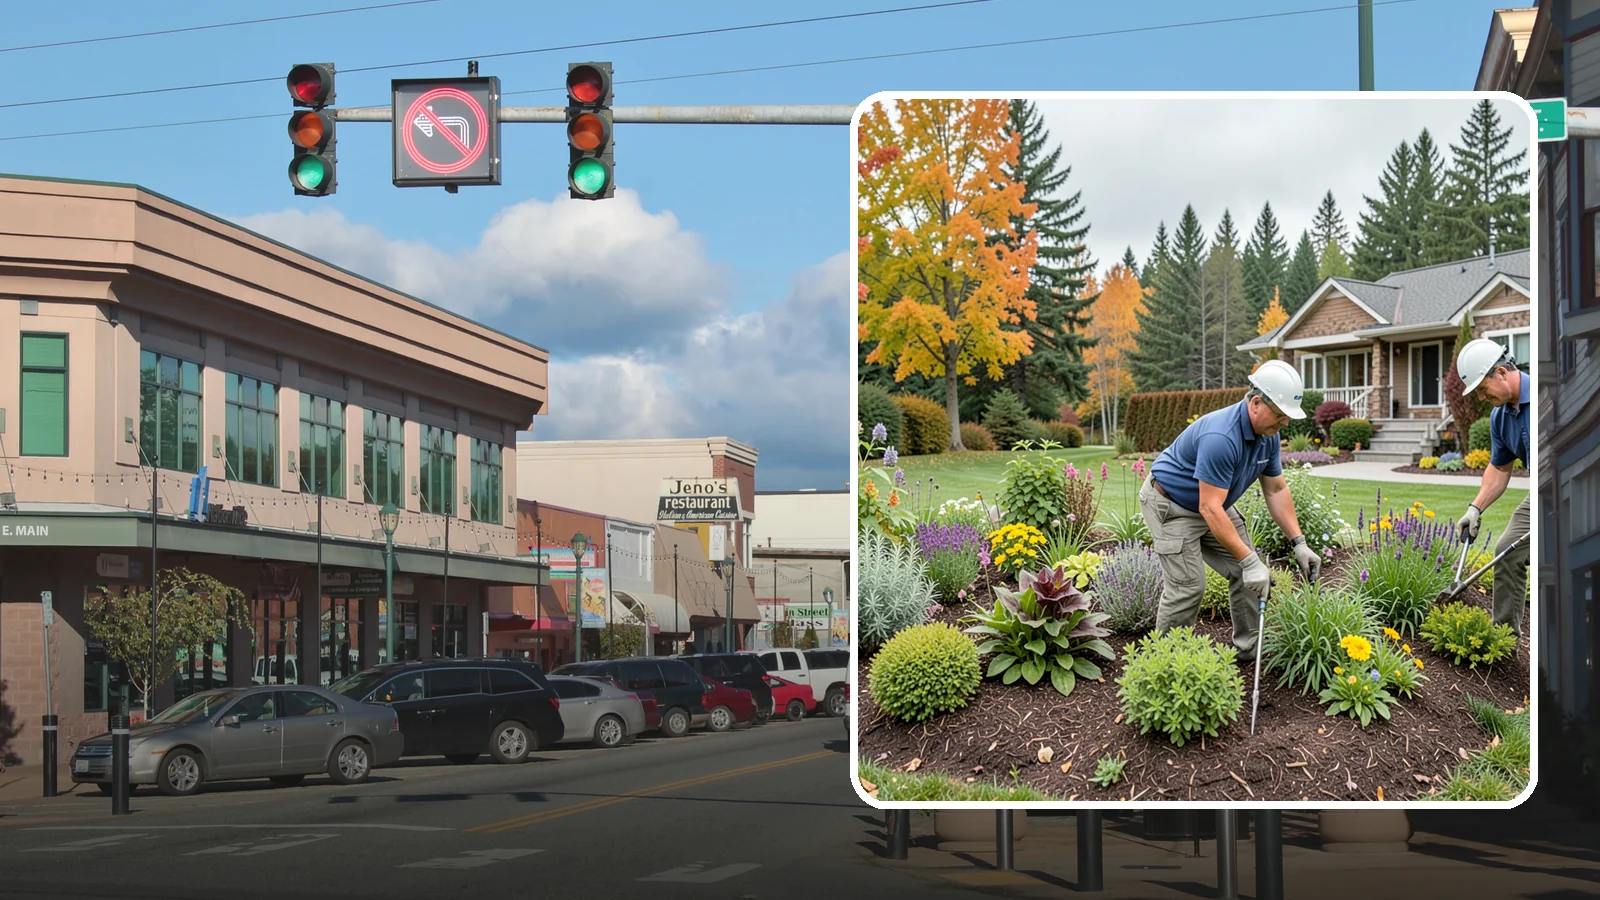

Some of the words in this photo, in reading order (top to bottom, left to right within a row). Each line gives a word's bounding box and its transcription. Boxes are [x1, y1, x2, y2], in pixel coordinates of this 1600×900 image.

[669, 480, 727, 494] Jeno's
[665, 496, 731, 509] restaurant
[658, 510, 682, 520] Italian
[686, 510, 714, 519] American
[714, 509, 737, 519] Cuisine
[2, 525, 13, 536] E.
[15, 525, 49, 536] MAIN
[797, 607, 829, 617] Street
[790, 619, 824, 627] lass
